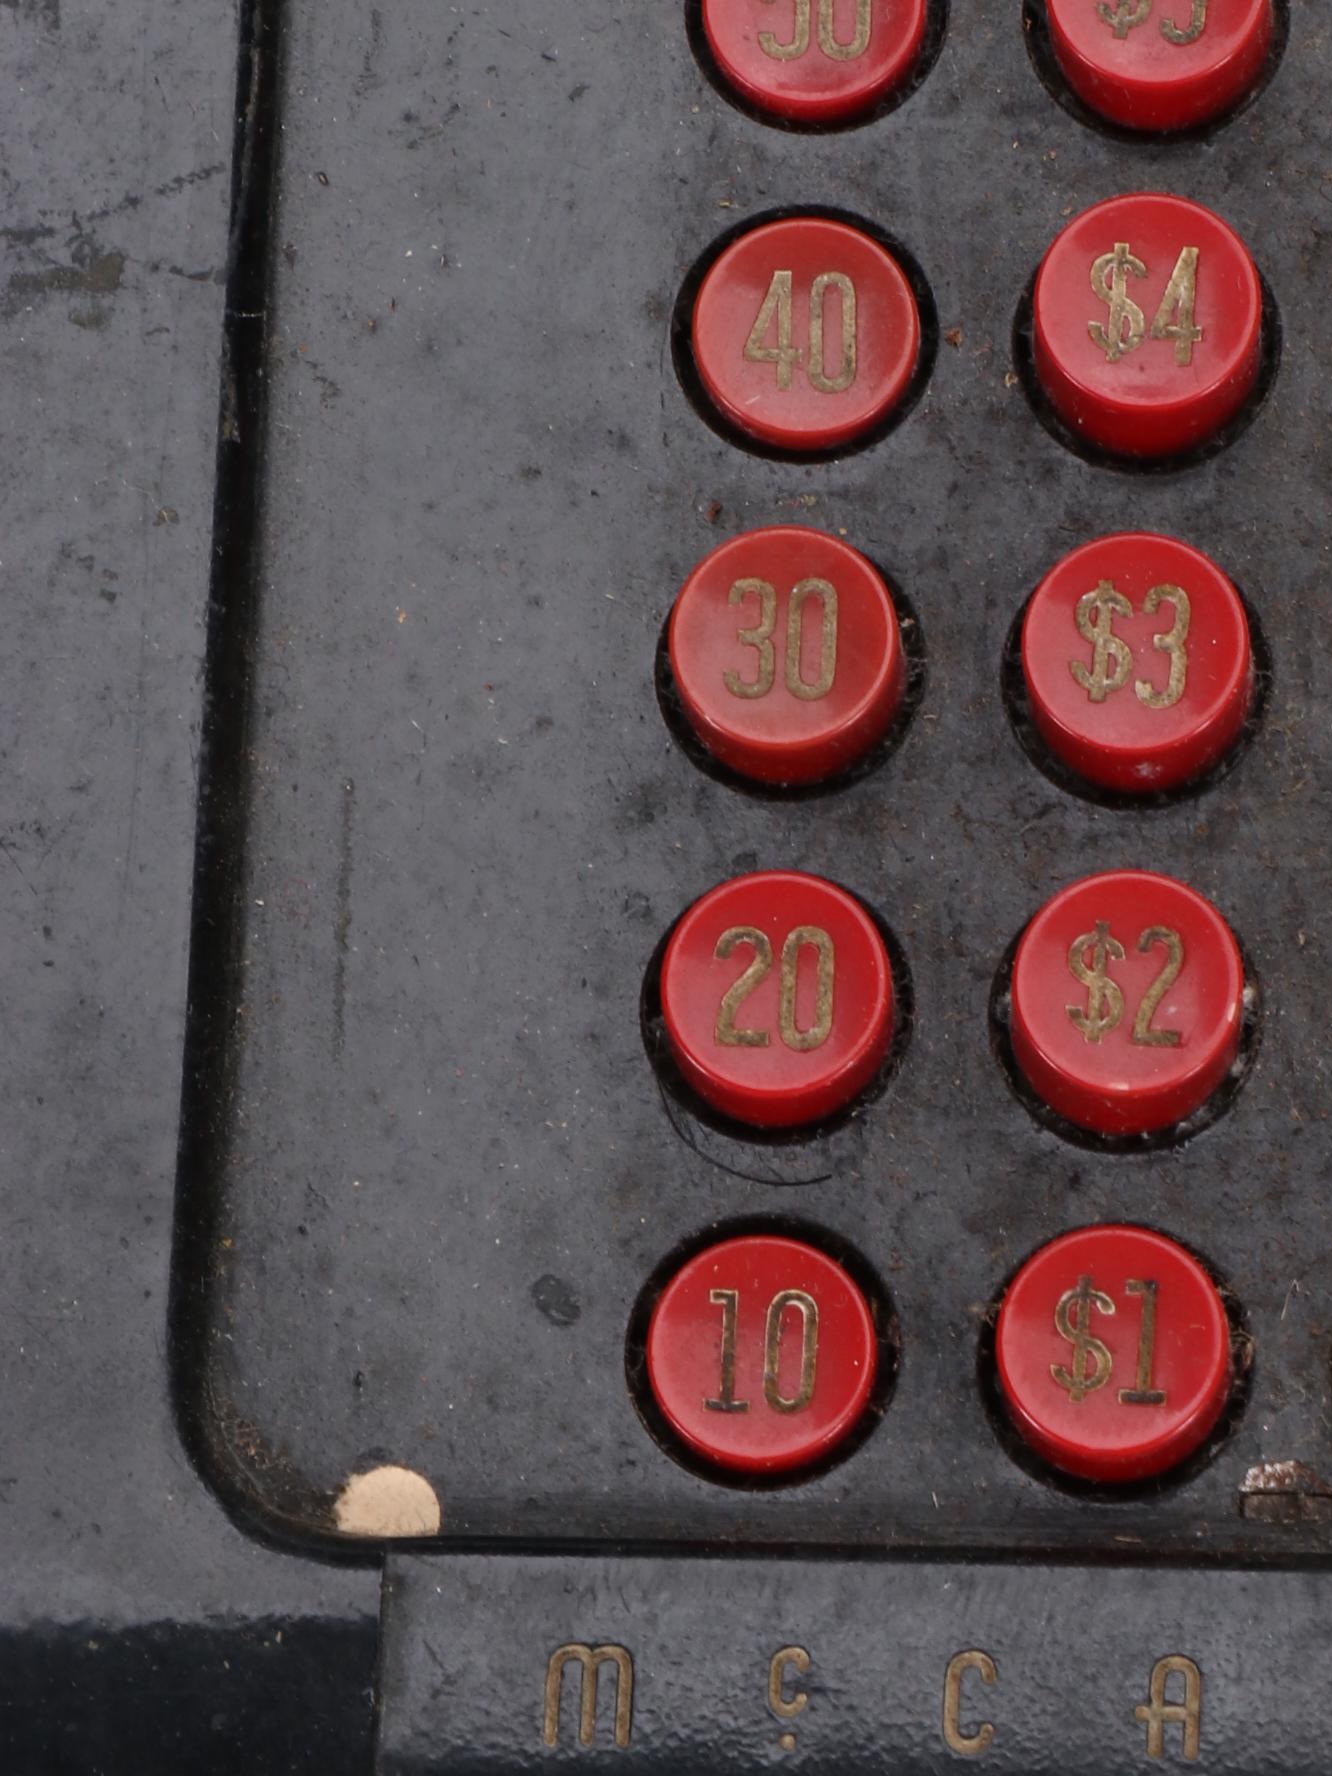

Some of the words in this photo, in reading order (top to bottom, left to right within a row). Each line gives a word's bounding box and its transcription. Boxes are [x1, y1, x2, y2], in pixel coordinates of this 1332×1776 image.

[742, 270, 857, 394] 40
[1087, 242, 1203, 367] $4
[722, 577, 838, 701] 30
[1069, 579, 1191, 709] $3
[713, 926, 835, 1052] 20
[1065, 920, 1188, 1048] $2
[703, 1288, 819, 1414] 10
[1049, 1275, 1167, 1405] $1
